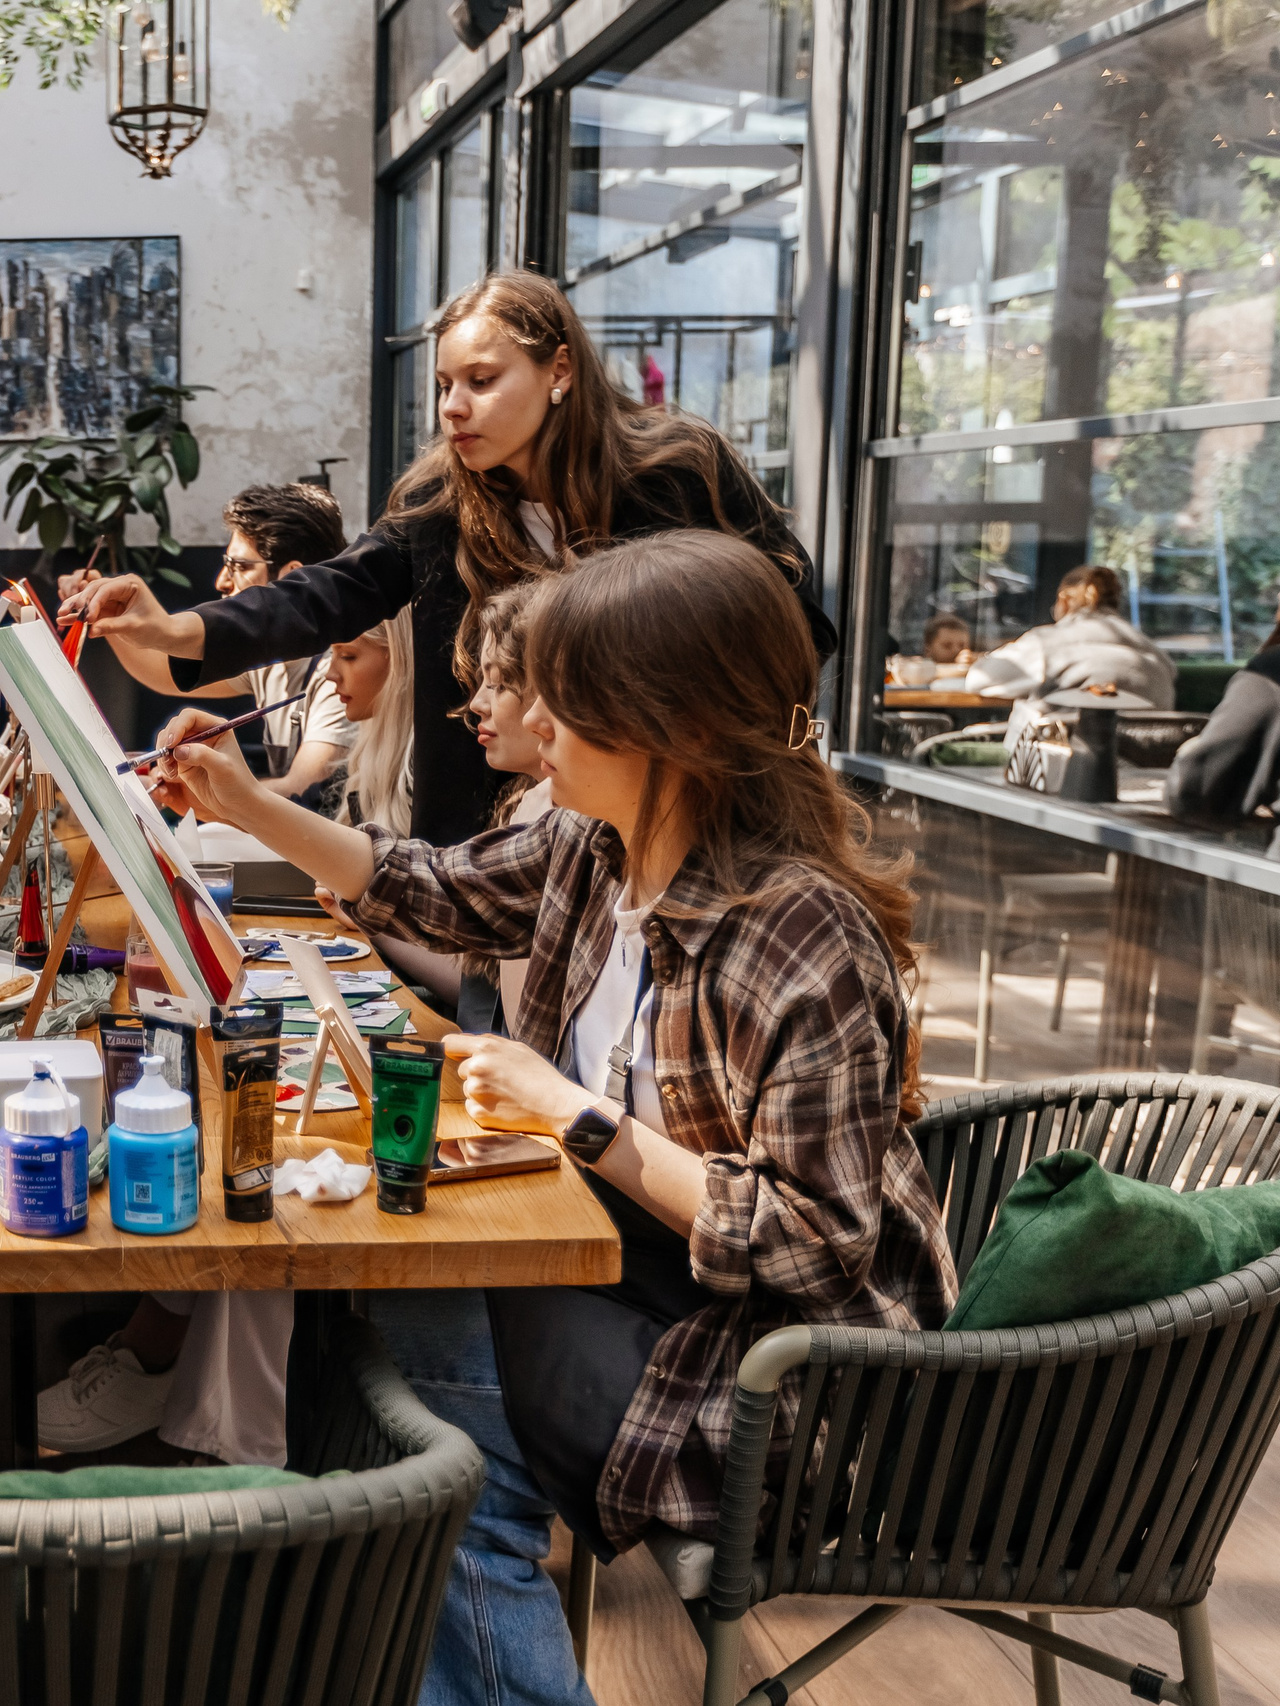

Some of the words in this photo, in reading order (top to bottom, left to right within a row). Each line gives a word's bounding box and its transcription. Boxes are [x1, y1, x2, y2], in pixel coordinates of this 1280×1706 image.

[116, 1037, 143, 1046] BRAUB
[386, 1061, 429, 1074] BRAUBERG
[10, 1153, 41, 1161] BRAUBERG
[11, 1174, 34, 1182] ACRYLIC
[23, 1197, 37, 1205] 250
